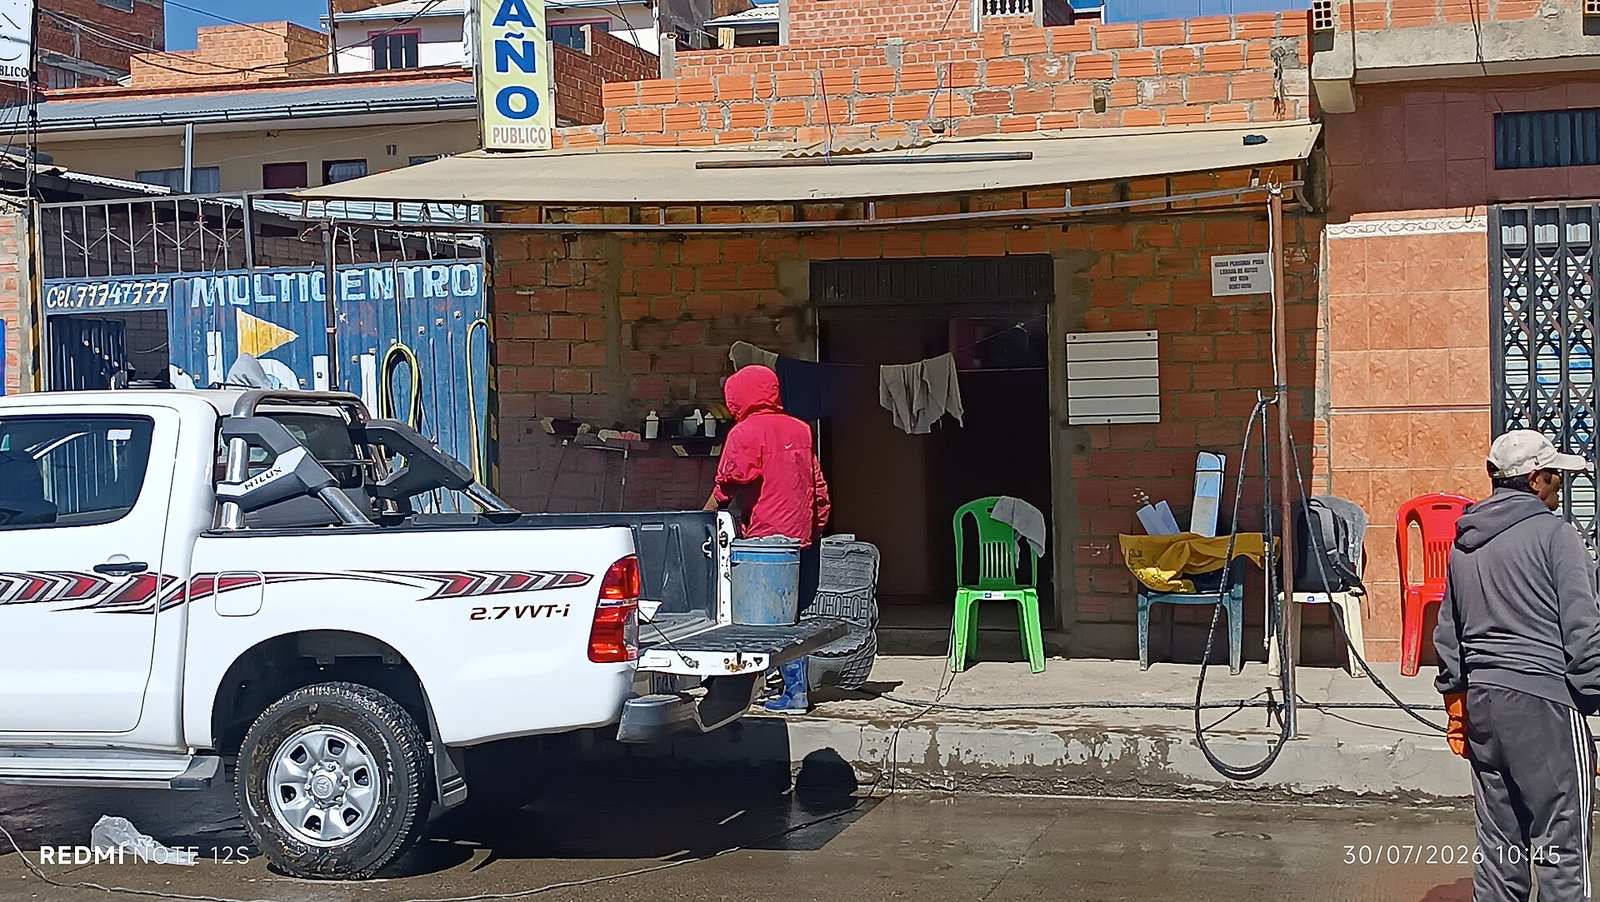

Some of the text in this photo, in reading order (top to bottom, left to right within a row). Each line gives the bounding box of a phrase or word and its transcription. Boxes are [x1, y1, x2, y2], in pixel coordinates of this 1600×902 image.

[492, 127, 547, 144] PUBLICO
[244, 466, 283, 491] HILUX
[470, 606, 510, 620] 2.7
